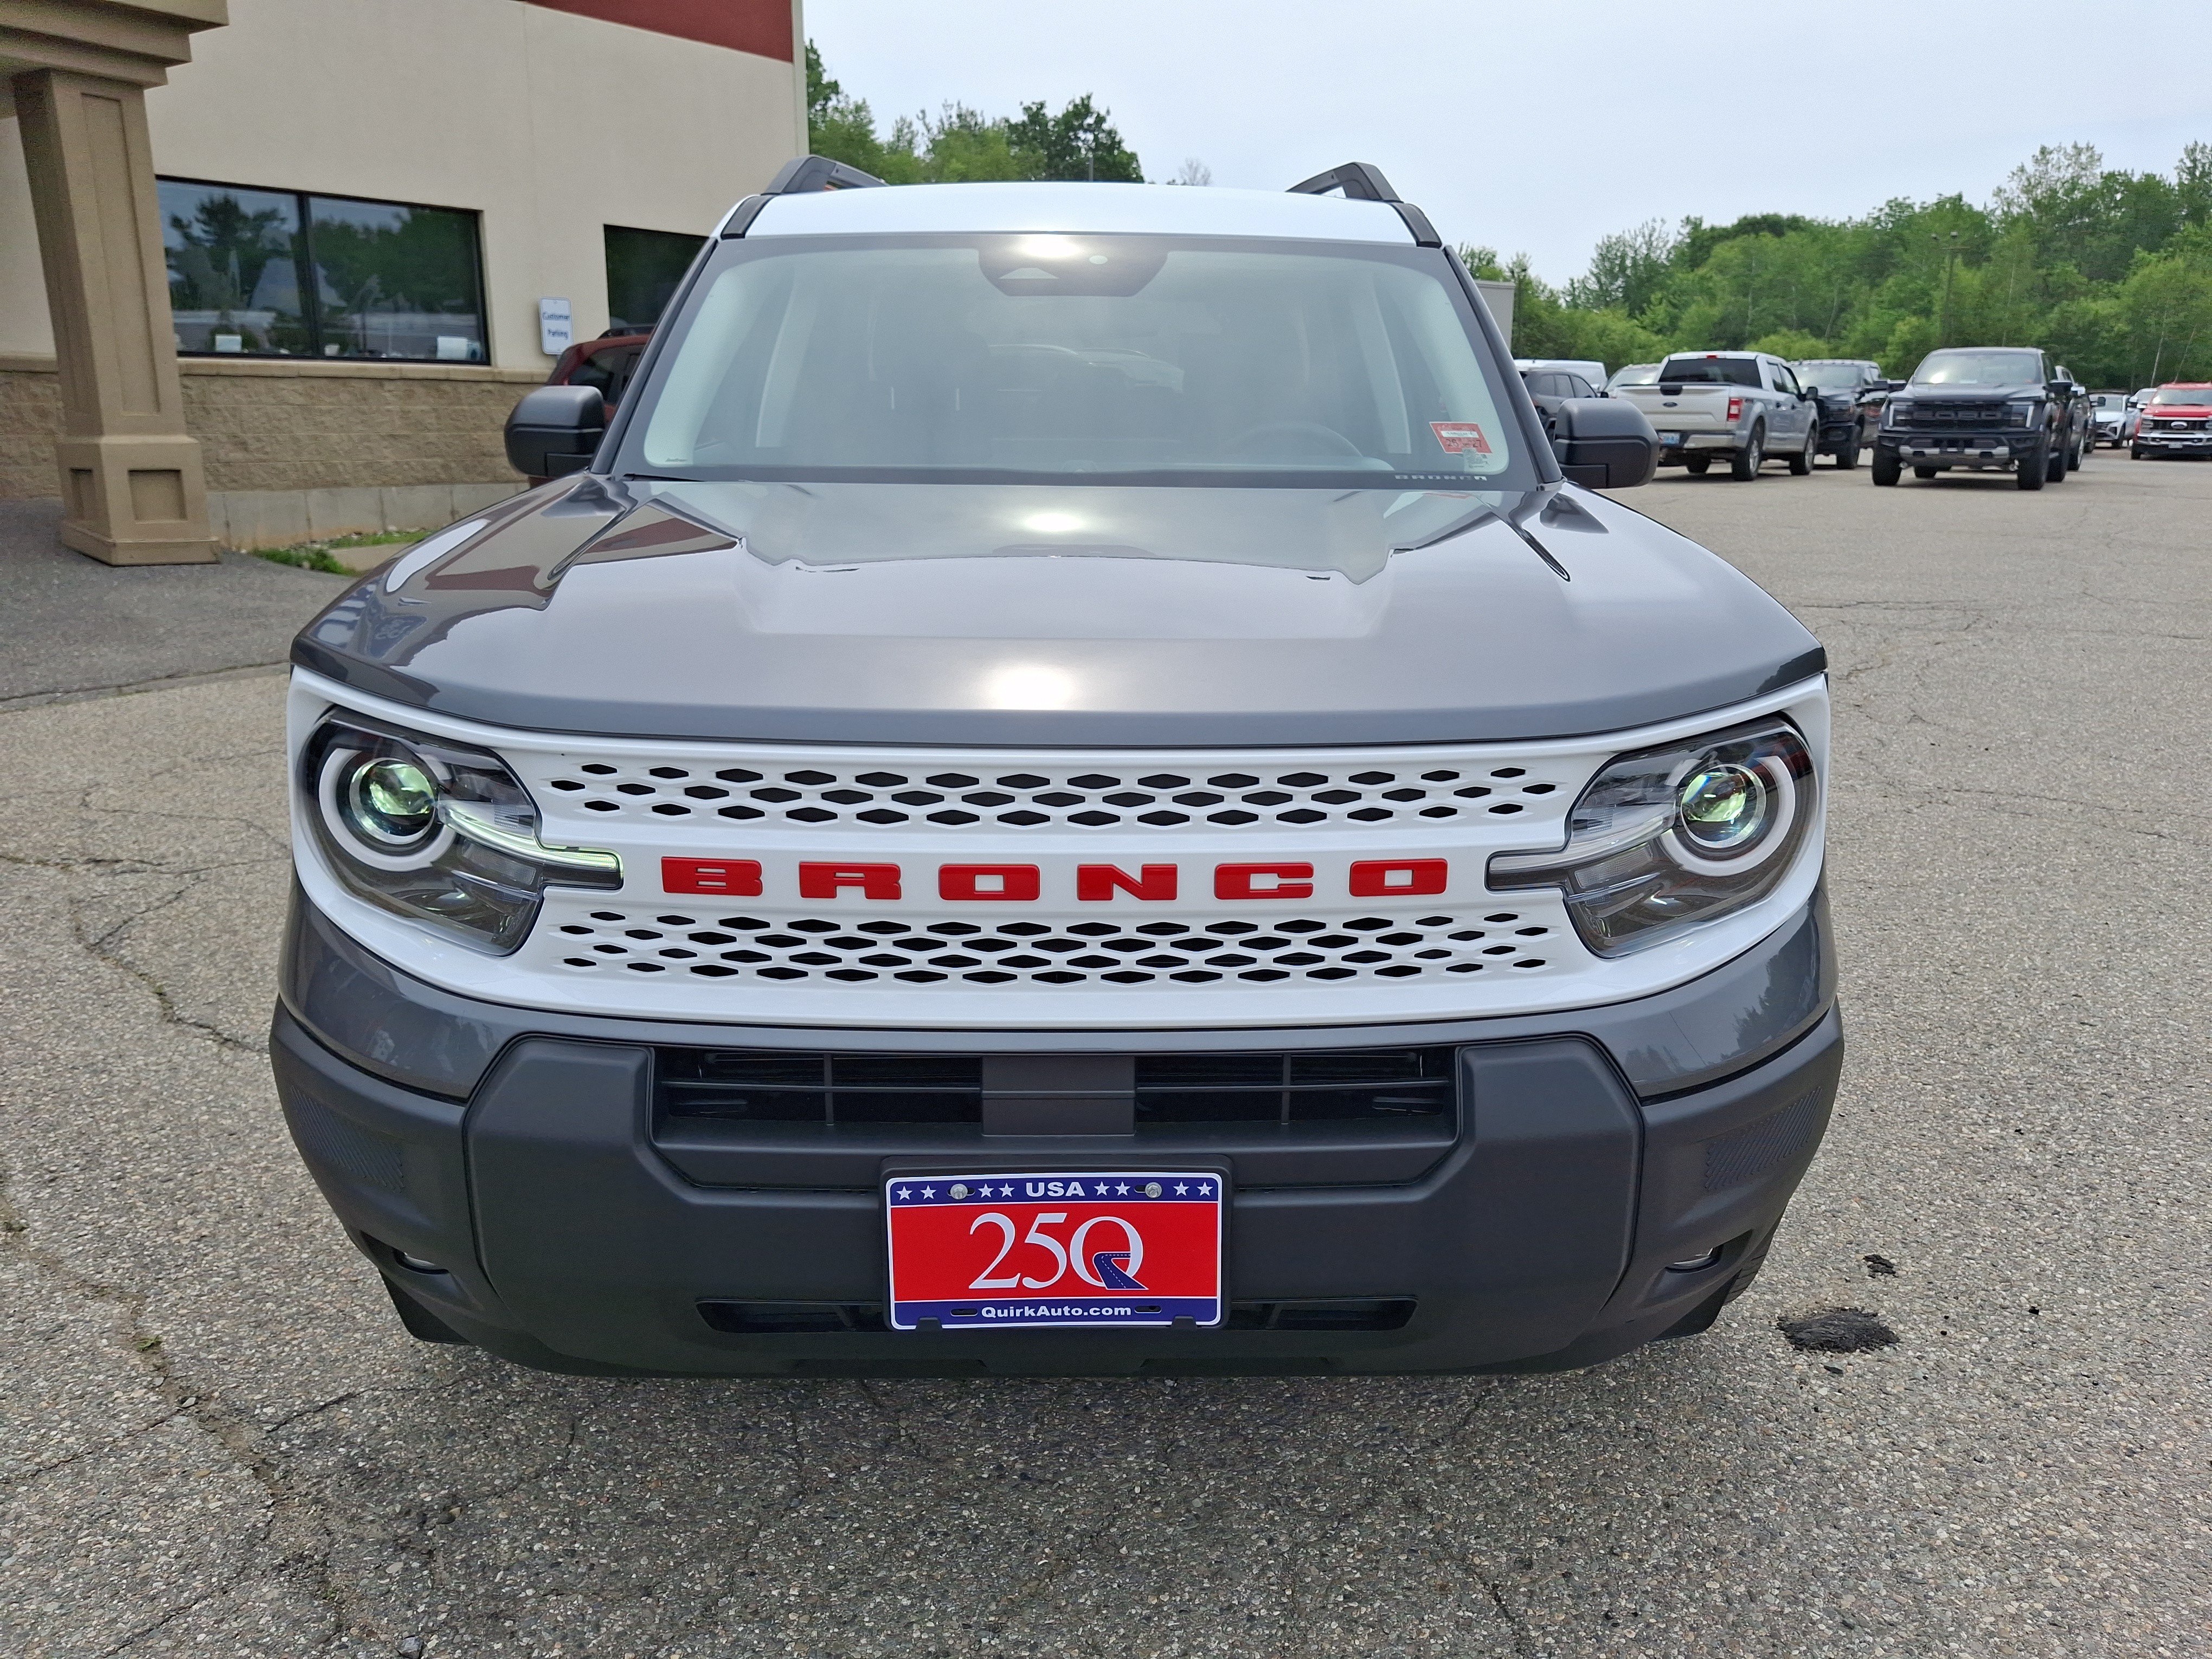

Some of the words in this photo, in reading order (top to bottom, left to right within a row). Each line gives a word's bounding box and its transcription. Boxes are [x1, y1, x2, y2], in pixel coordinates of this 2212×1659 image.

[548, 328, 568, 339] Parking
[661, 856, 1448, 901] BRONCO
[1026, 1181, 1085, 1197] USA
[981, 1305, 1131, 1318] QuirkAuto.com
